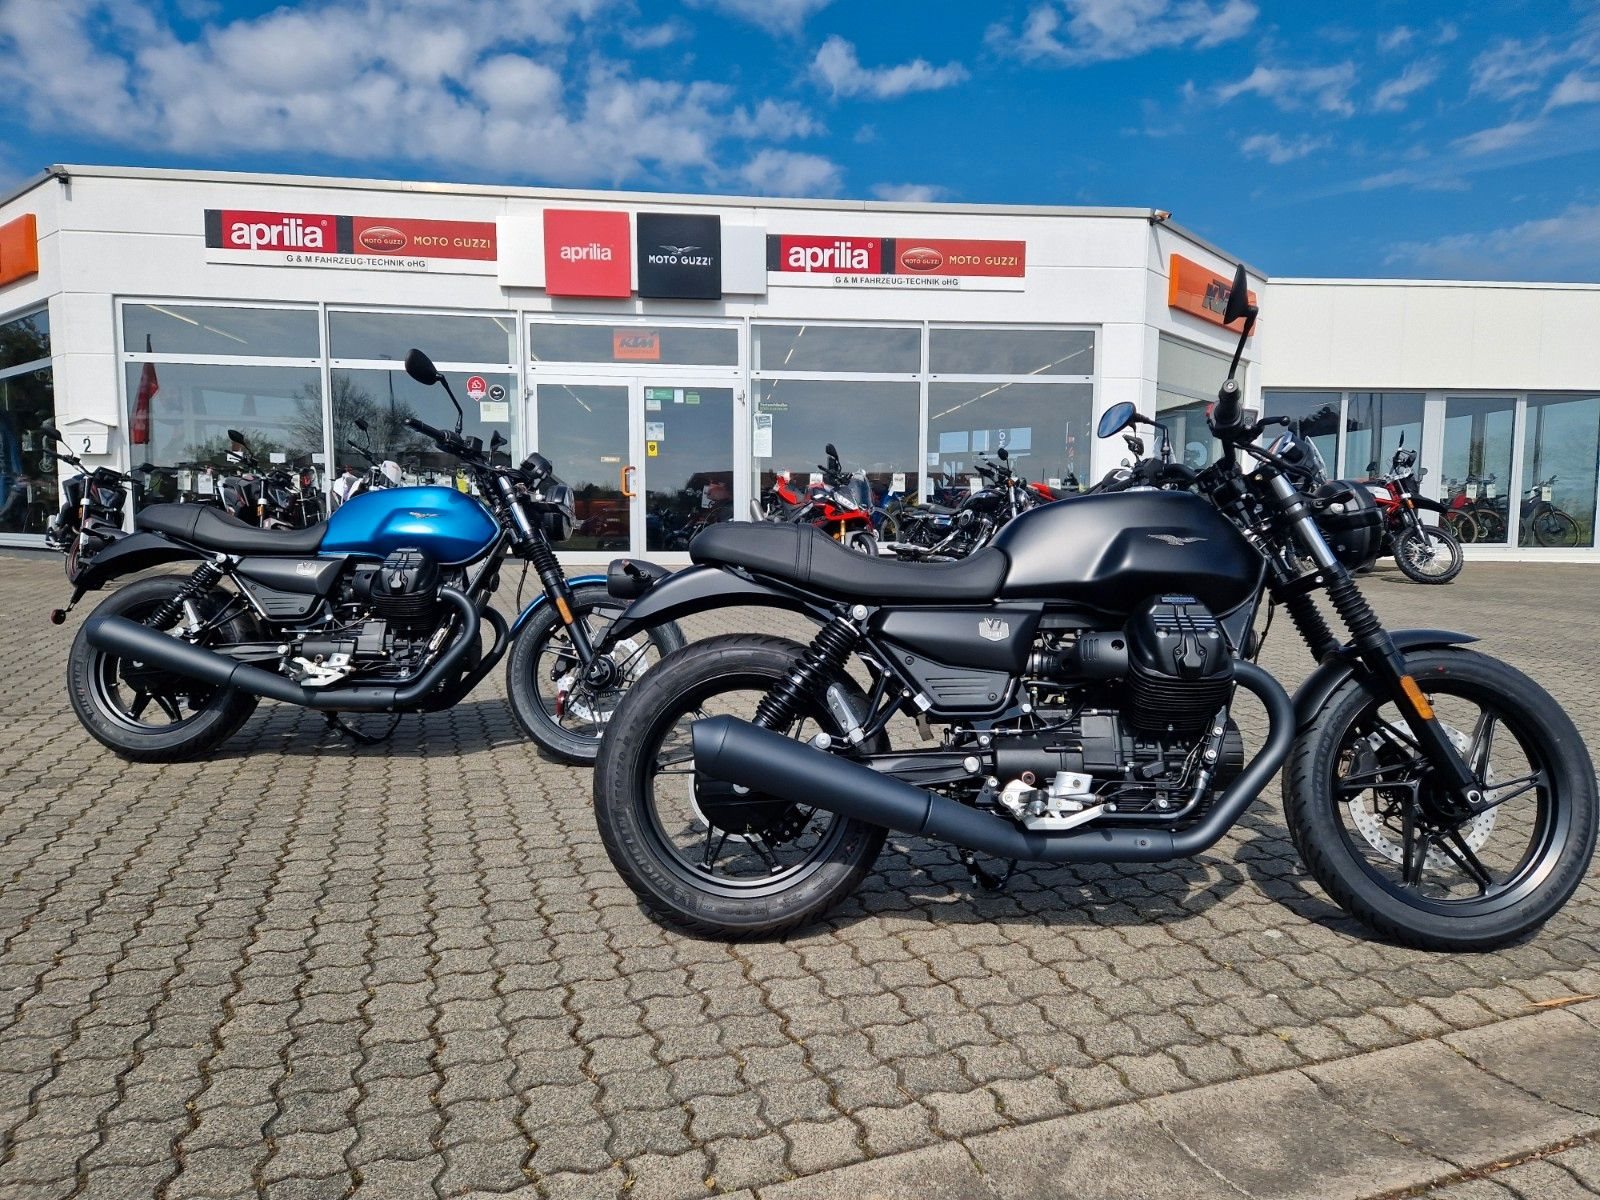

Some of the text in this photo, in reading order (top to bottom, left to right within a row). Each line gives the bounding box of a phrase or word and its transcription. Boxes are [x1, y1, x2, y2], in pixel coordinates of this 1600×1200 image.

[231, 218, 323, 250] aprilia
[413, 236, 491, 248] MOTO GUZZI
[560, 243, 612, 263] aprilia
[648, 254, 711, 266] MOTO GUZZI
[788, 241, 869, 272] aprilia
[286, 254, 426, 267] G & M FAHRZEUG-TECHNIK oHG
[949, 255, 1018, 266] MOTO GUZZI
[860, 276, 940, 286] FAHRZEUG-TECHNIK
[83, 438, 91, 453] 2
[998, 429, 1006, 448] MO
